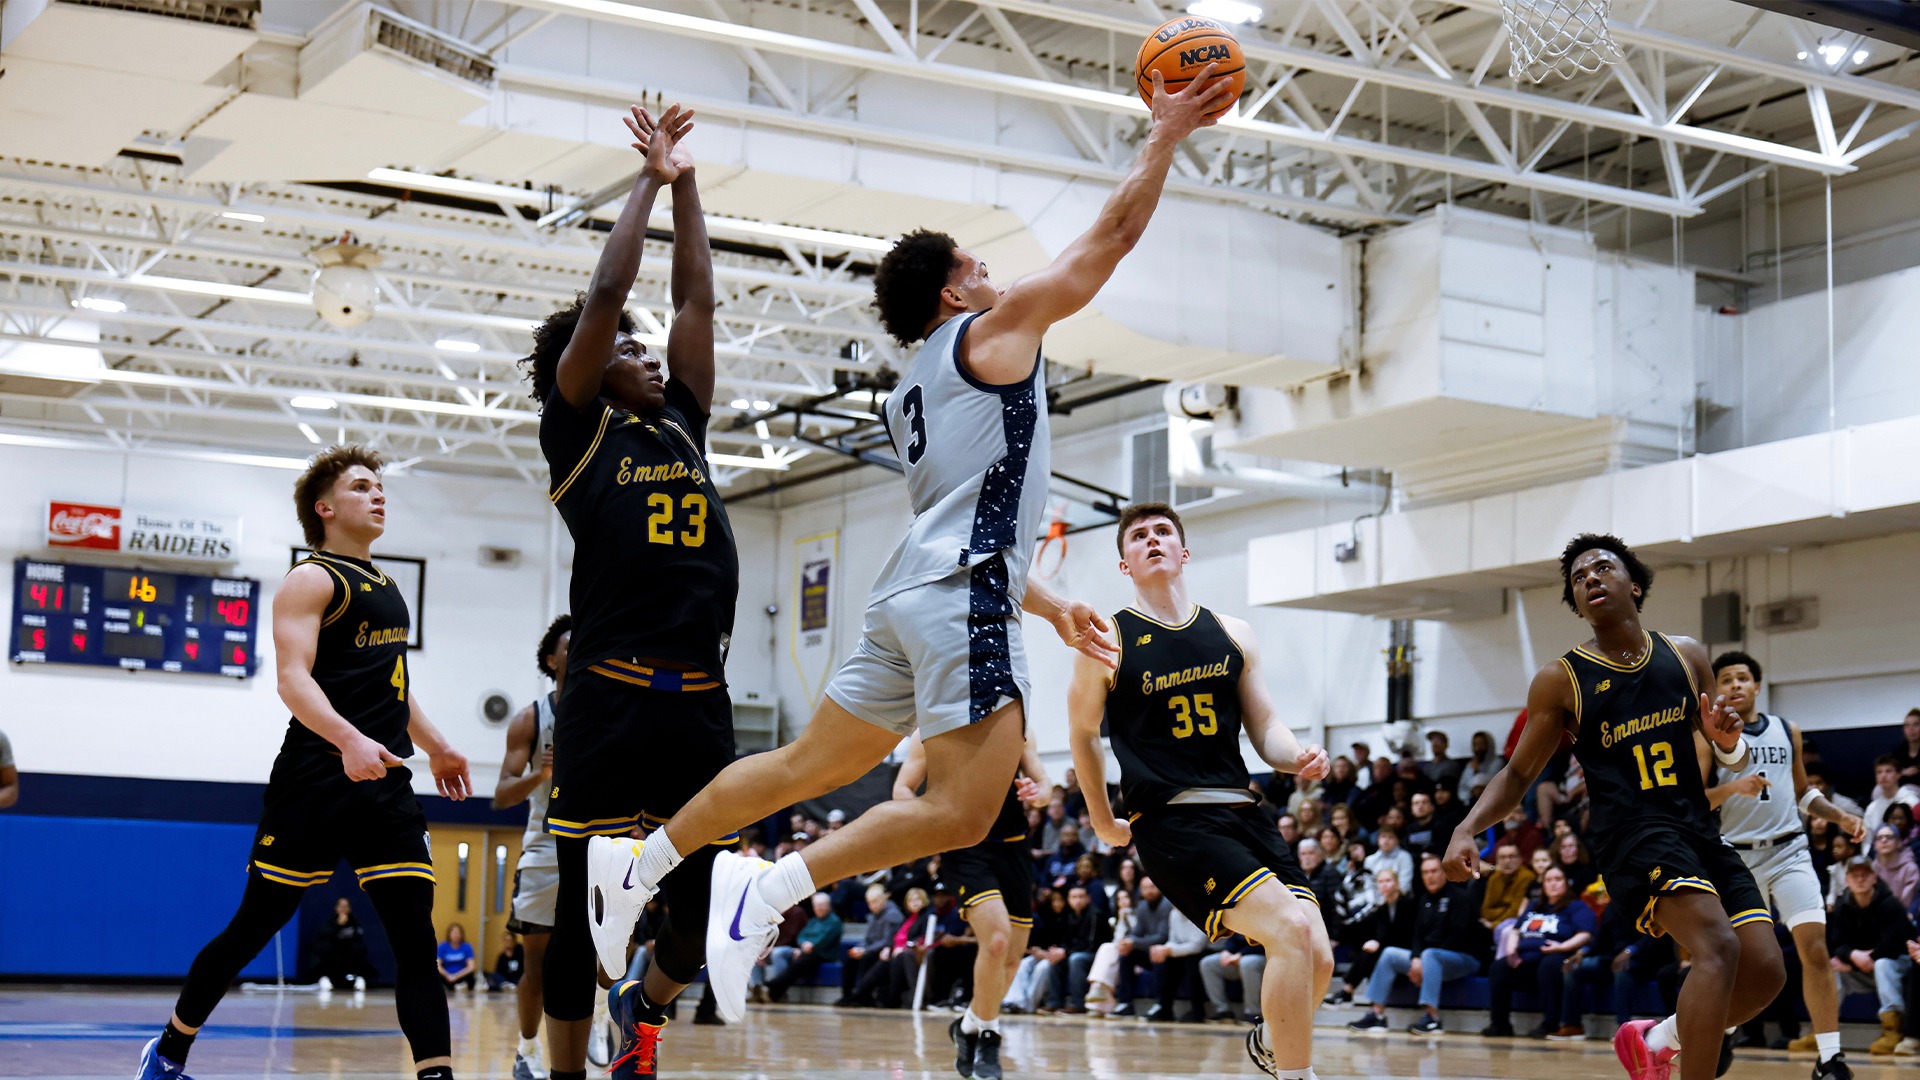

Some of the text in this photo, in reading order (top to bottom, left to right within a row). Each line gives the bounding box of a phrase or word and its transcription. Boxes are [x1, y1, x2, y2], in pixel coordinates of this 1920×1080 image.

[1180, 44, 1231, 68] NCAA
[902, 383, 928, 467] 3
[137, 516, 223, 535] Home Of The
[648, 493, 708, 547] 23
[129, 529, 231, 559] RAIDERS
[26, 562, 65, 583] HOME
[30, 583, 64, 610] 41
[211, 578, 252, 598] GUEST
[217, 599, 249, 627] 40
[390, 654, 405, 701] 4
[1142, 654, 1230, 696] Emmanuel
[1168, 693, 1218, 739] 35
[1600, 696, 1687, 748] Emmanuel
[1632, 741, 1678, 791] 12
[1749, 746, 1788, 765] VIER
